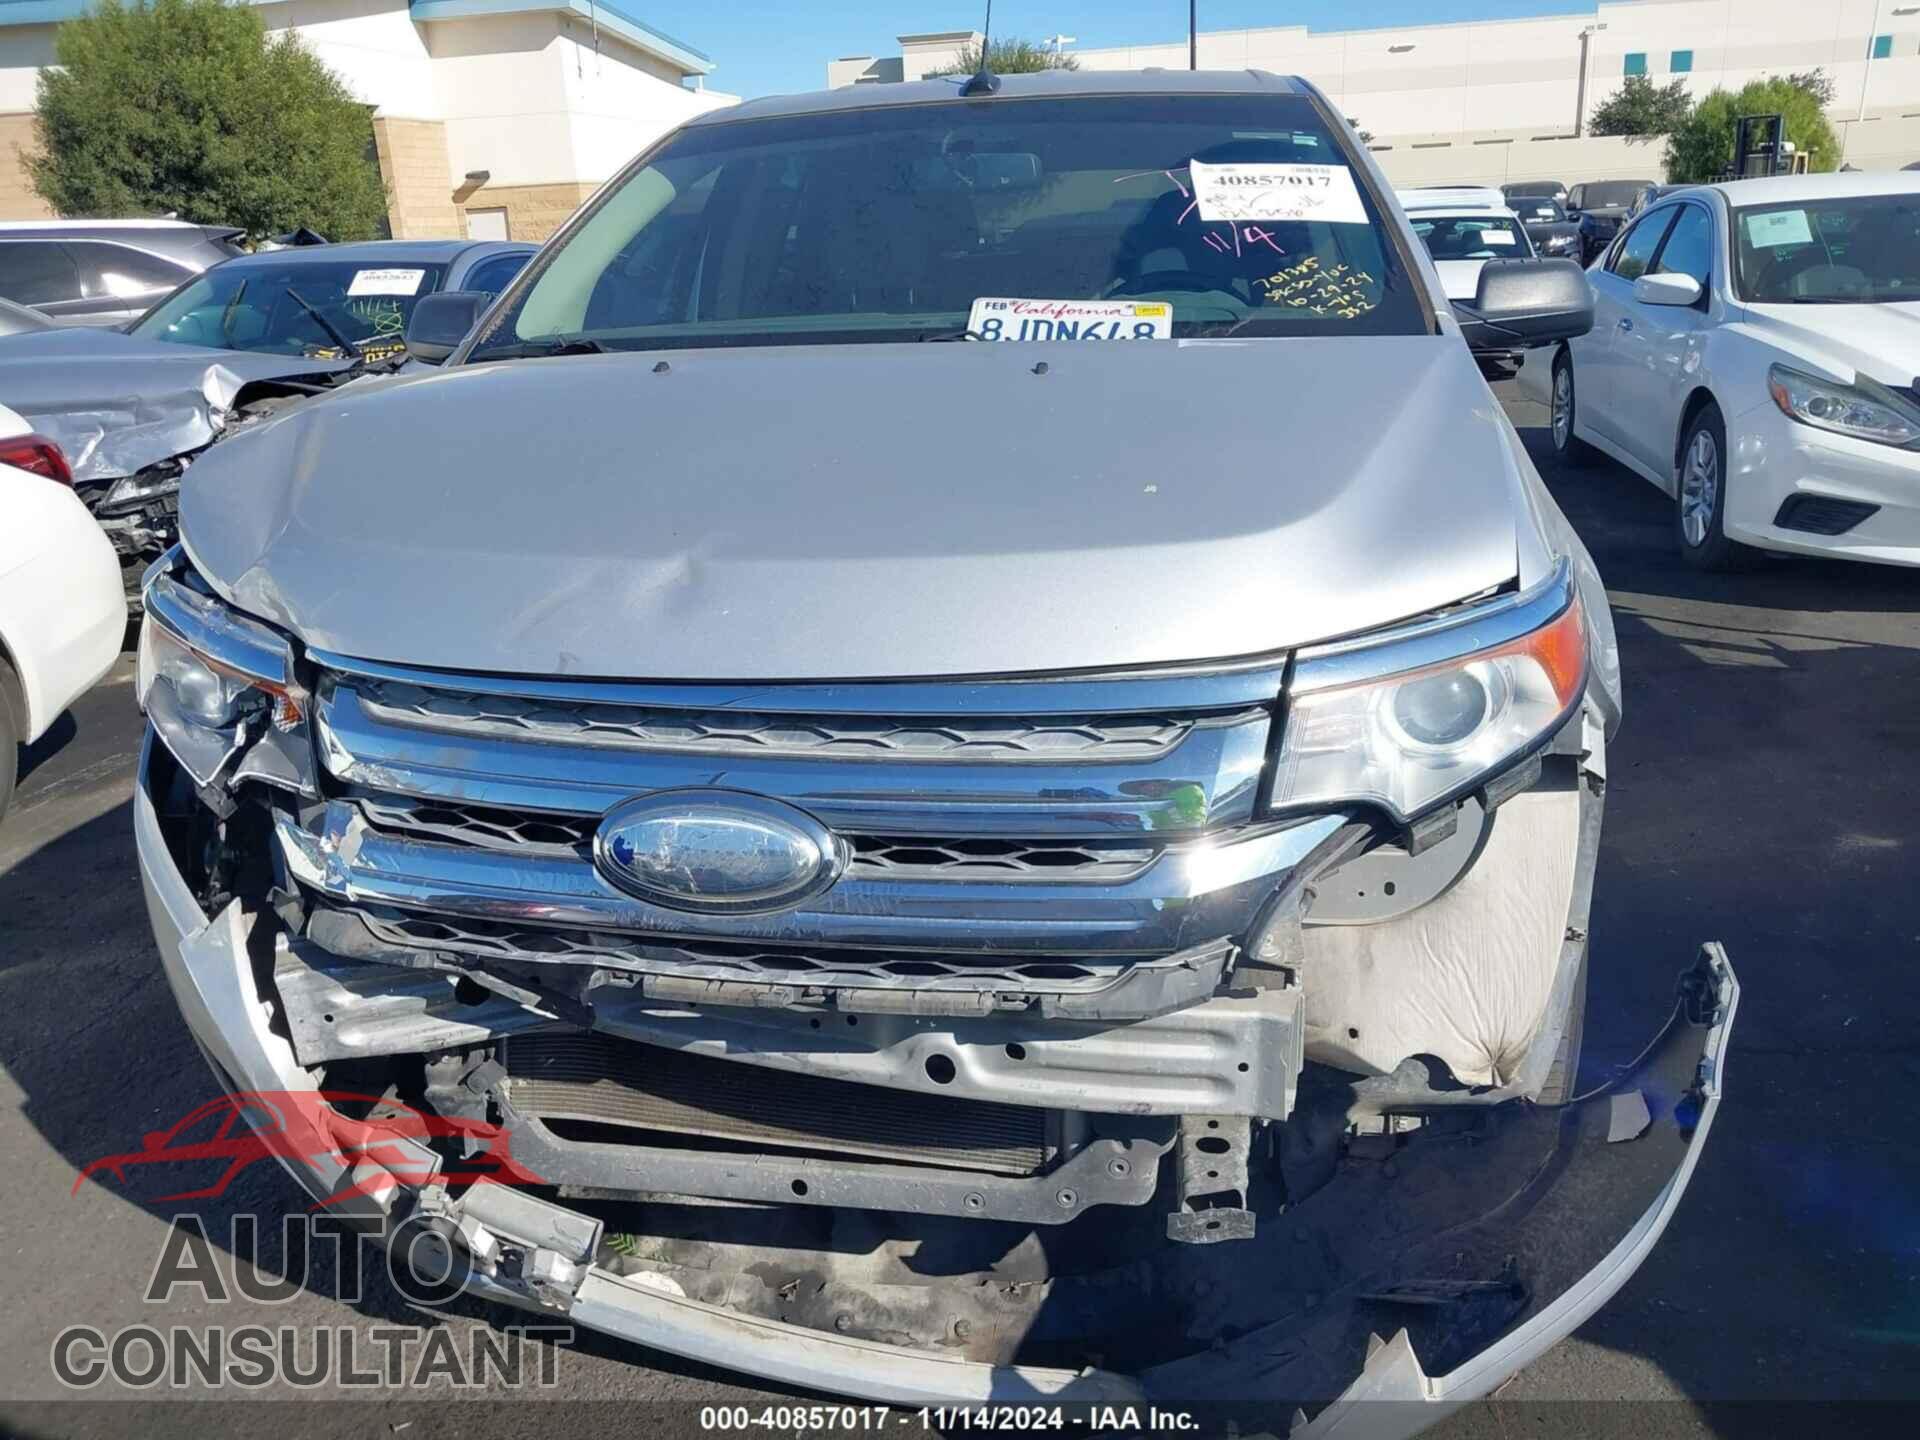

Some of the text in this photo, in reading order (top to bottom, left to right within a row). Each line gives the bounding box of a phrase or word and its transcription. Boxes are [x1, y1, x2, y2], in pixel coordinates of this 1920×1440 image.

[1213, 174, 1332, 187] 40857017
[985, 302, 1007, 310] FEB
[1013, 302, 1122, 320] California
